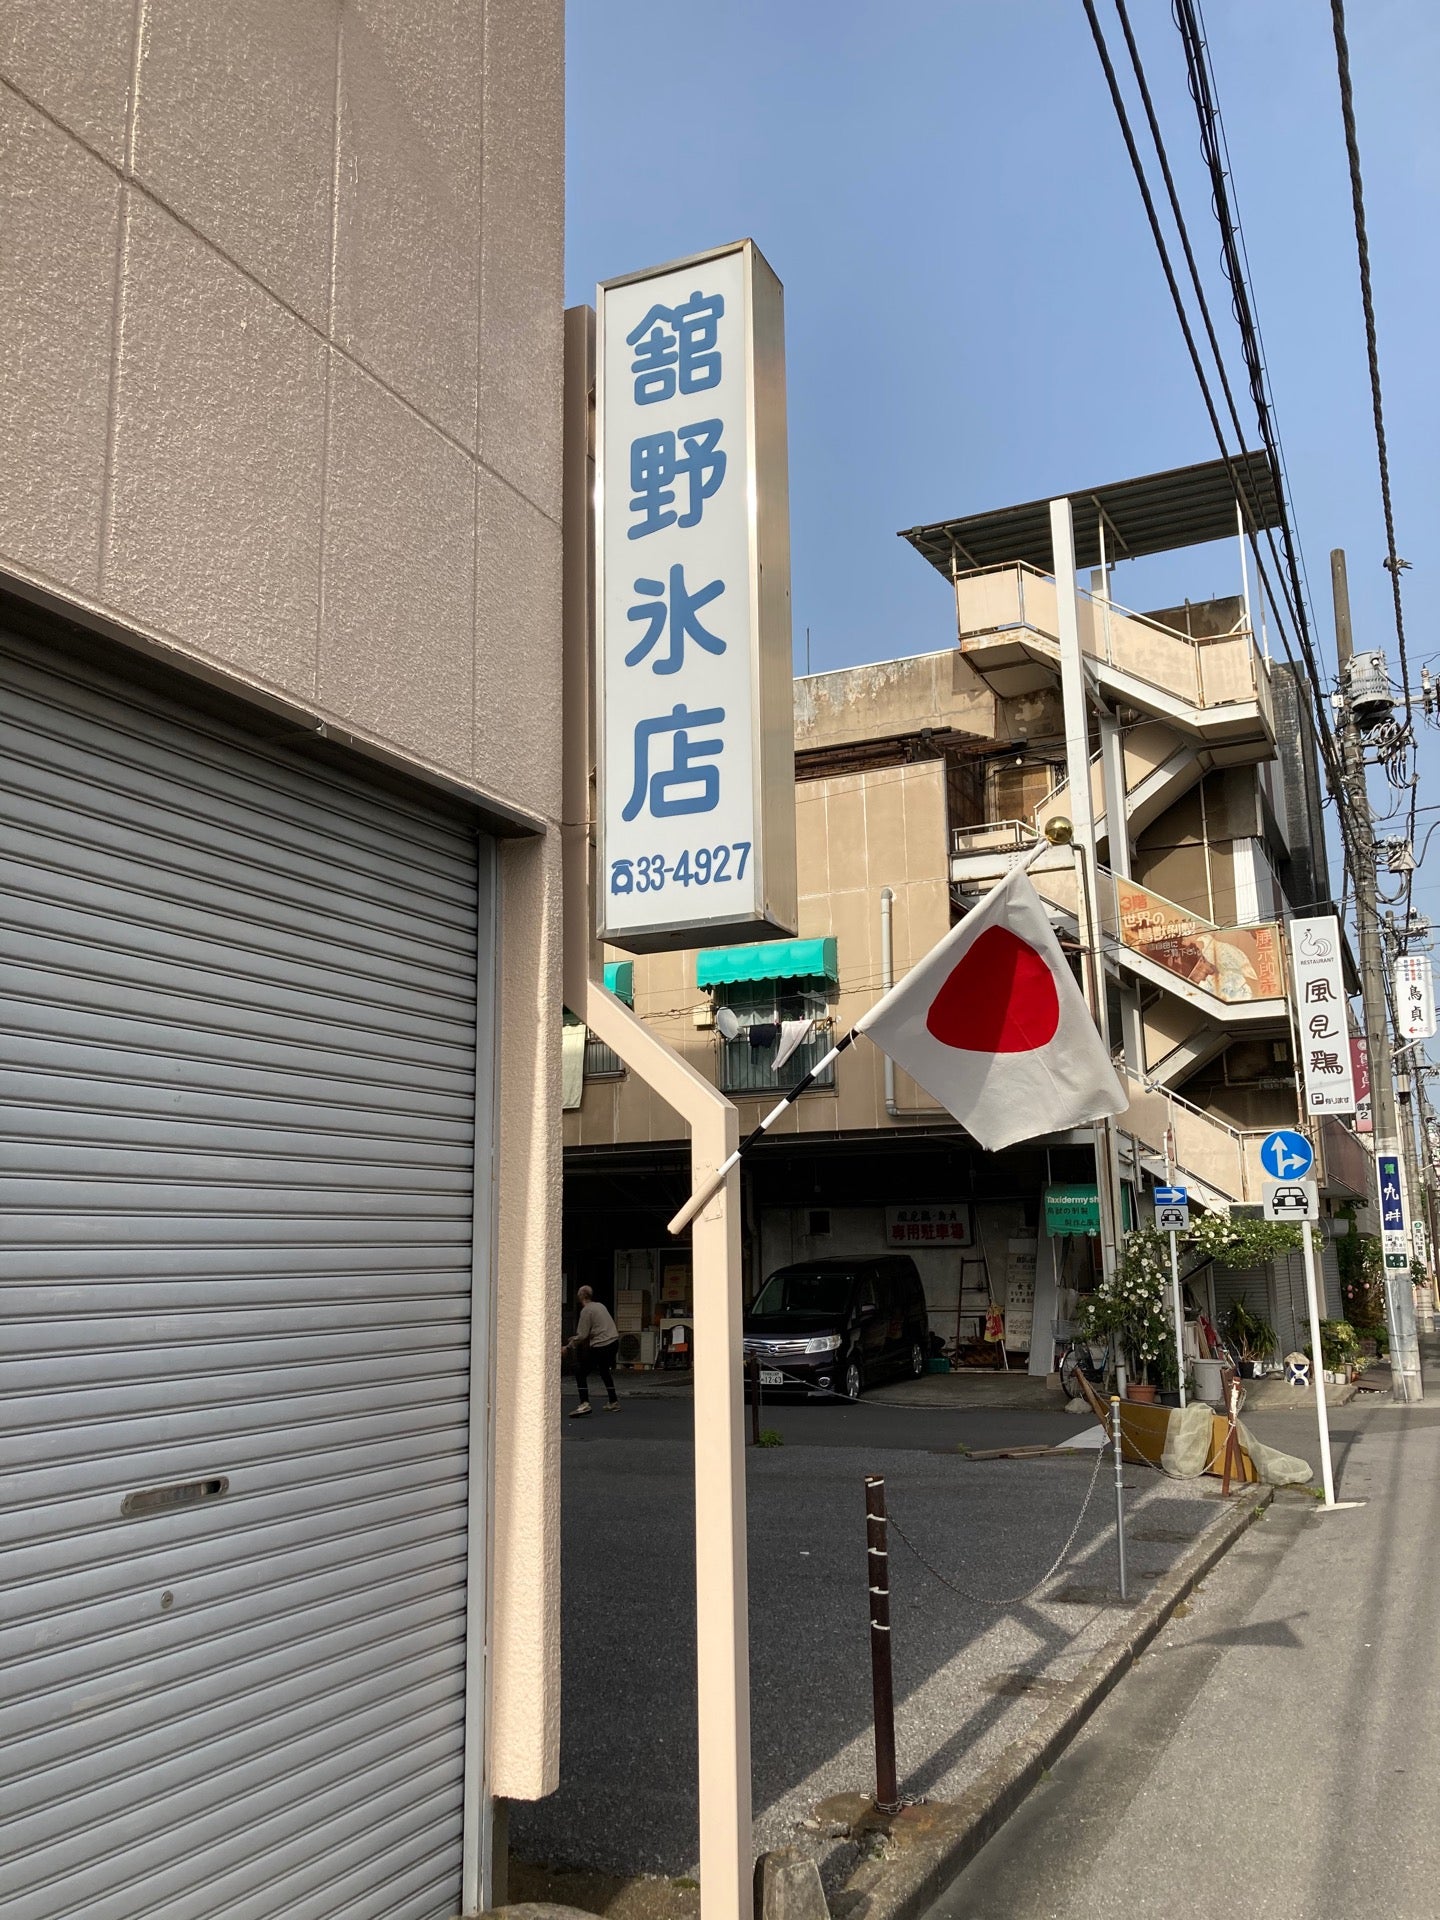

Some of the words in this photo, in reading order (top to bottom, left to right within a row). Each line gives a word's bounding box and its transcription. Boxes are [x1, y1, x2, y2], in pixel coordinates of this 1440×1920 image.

[622, 290, 728, 823] 舘野氷店
[635, 841, 752, 893] 33-4927
[1122, 911, 1164, 928] 世界の
[1300, 957, 1335, 966] RESTAURANT
[1407, 984, 1424, 1022] 鳥貞
[1305, 978, 1344, 1075] 風見鶏
[1047, 1195, 1089, 1205] Taxidermy
[892, 1223, 964, 1241] 専用駐車場
